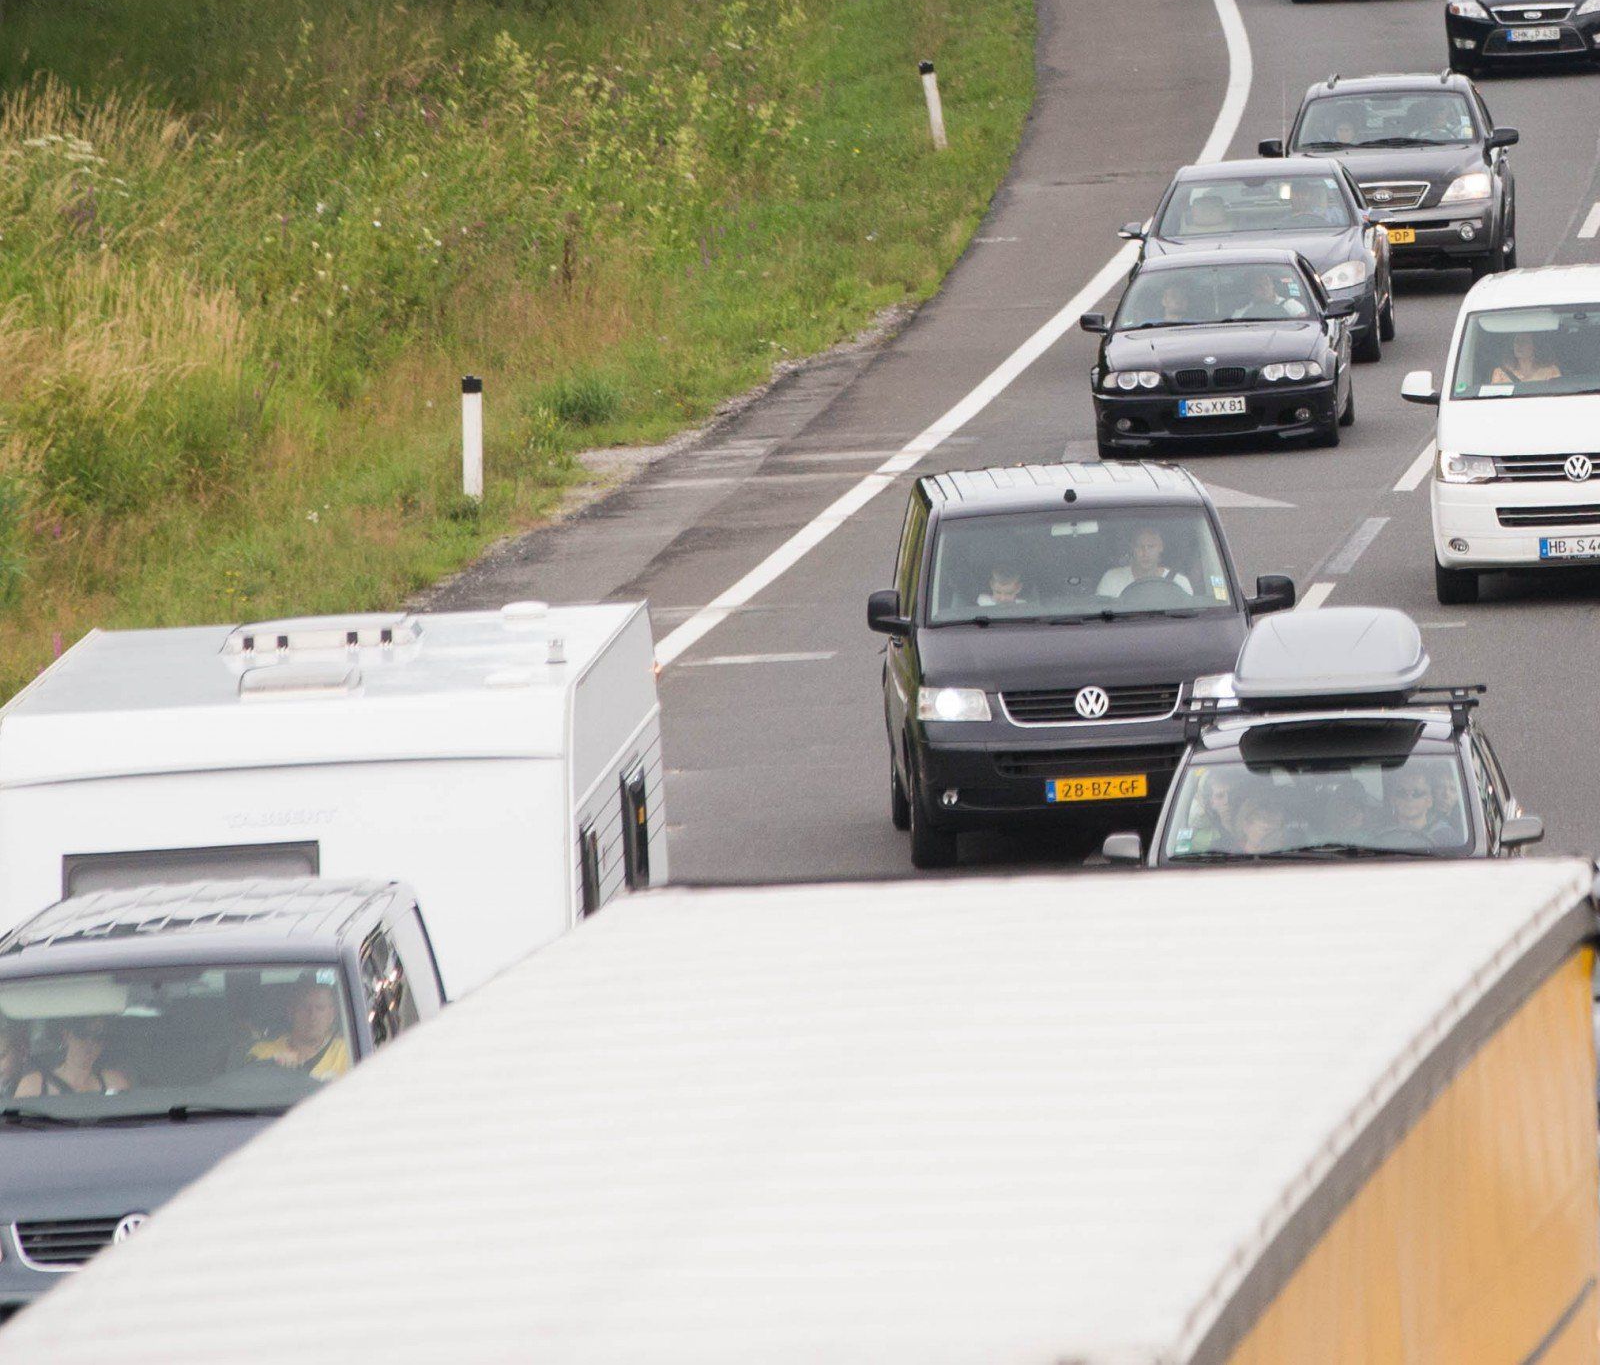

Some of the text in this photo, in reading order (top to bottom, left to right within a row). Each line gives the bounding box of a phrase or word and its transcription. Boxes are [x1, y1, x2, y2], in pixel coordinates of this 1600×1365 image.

[1187, 400, 1244, 414] KS XX 81
[1549, 540, 1567, 554] HB
[1576, 539, 1586, 553] S
[1062, 780, 1140, 798] 28-BZ-GF
